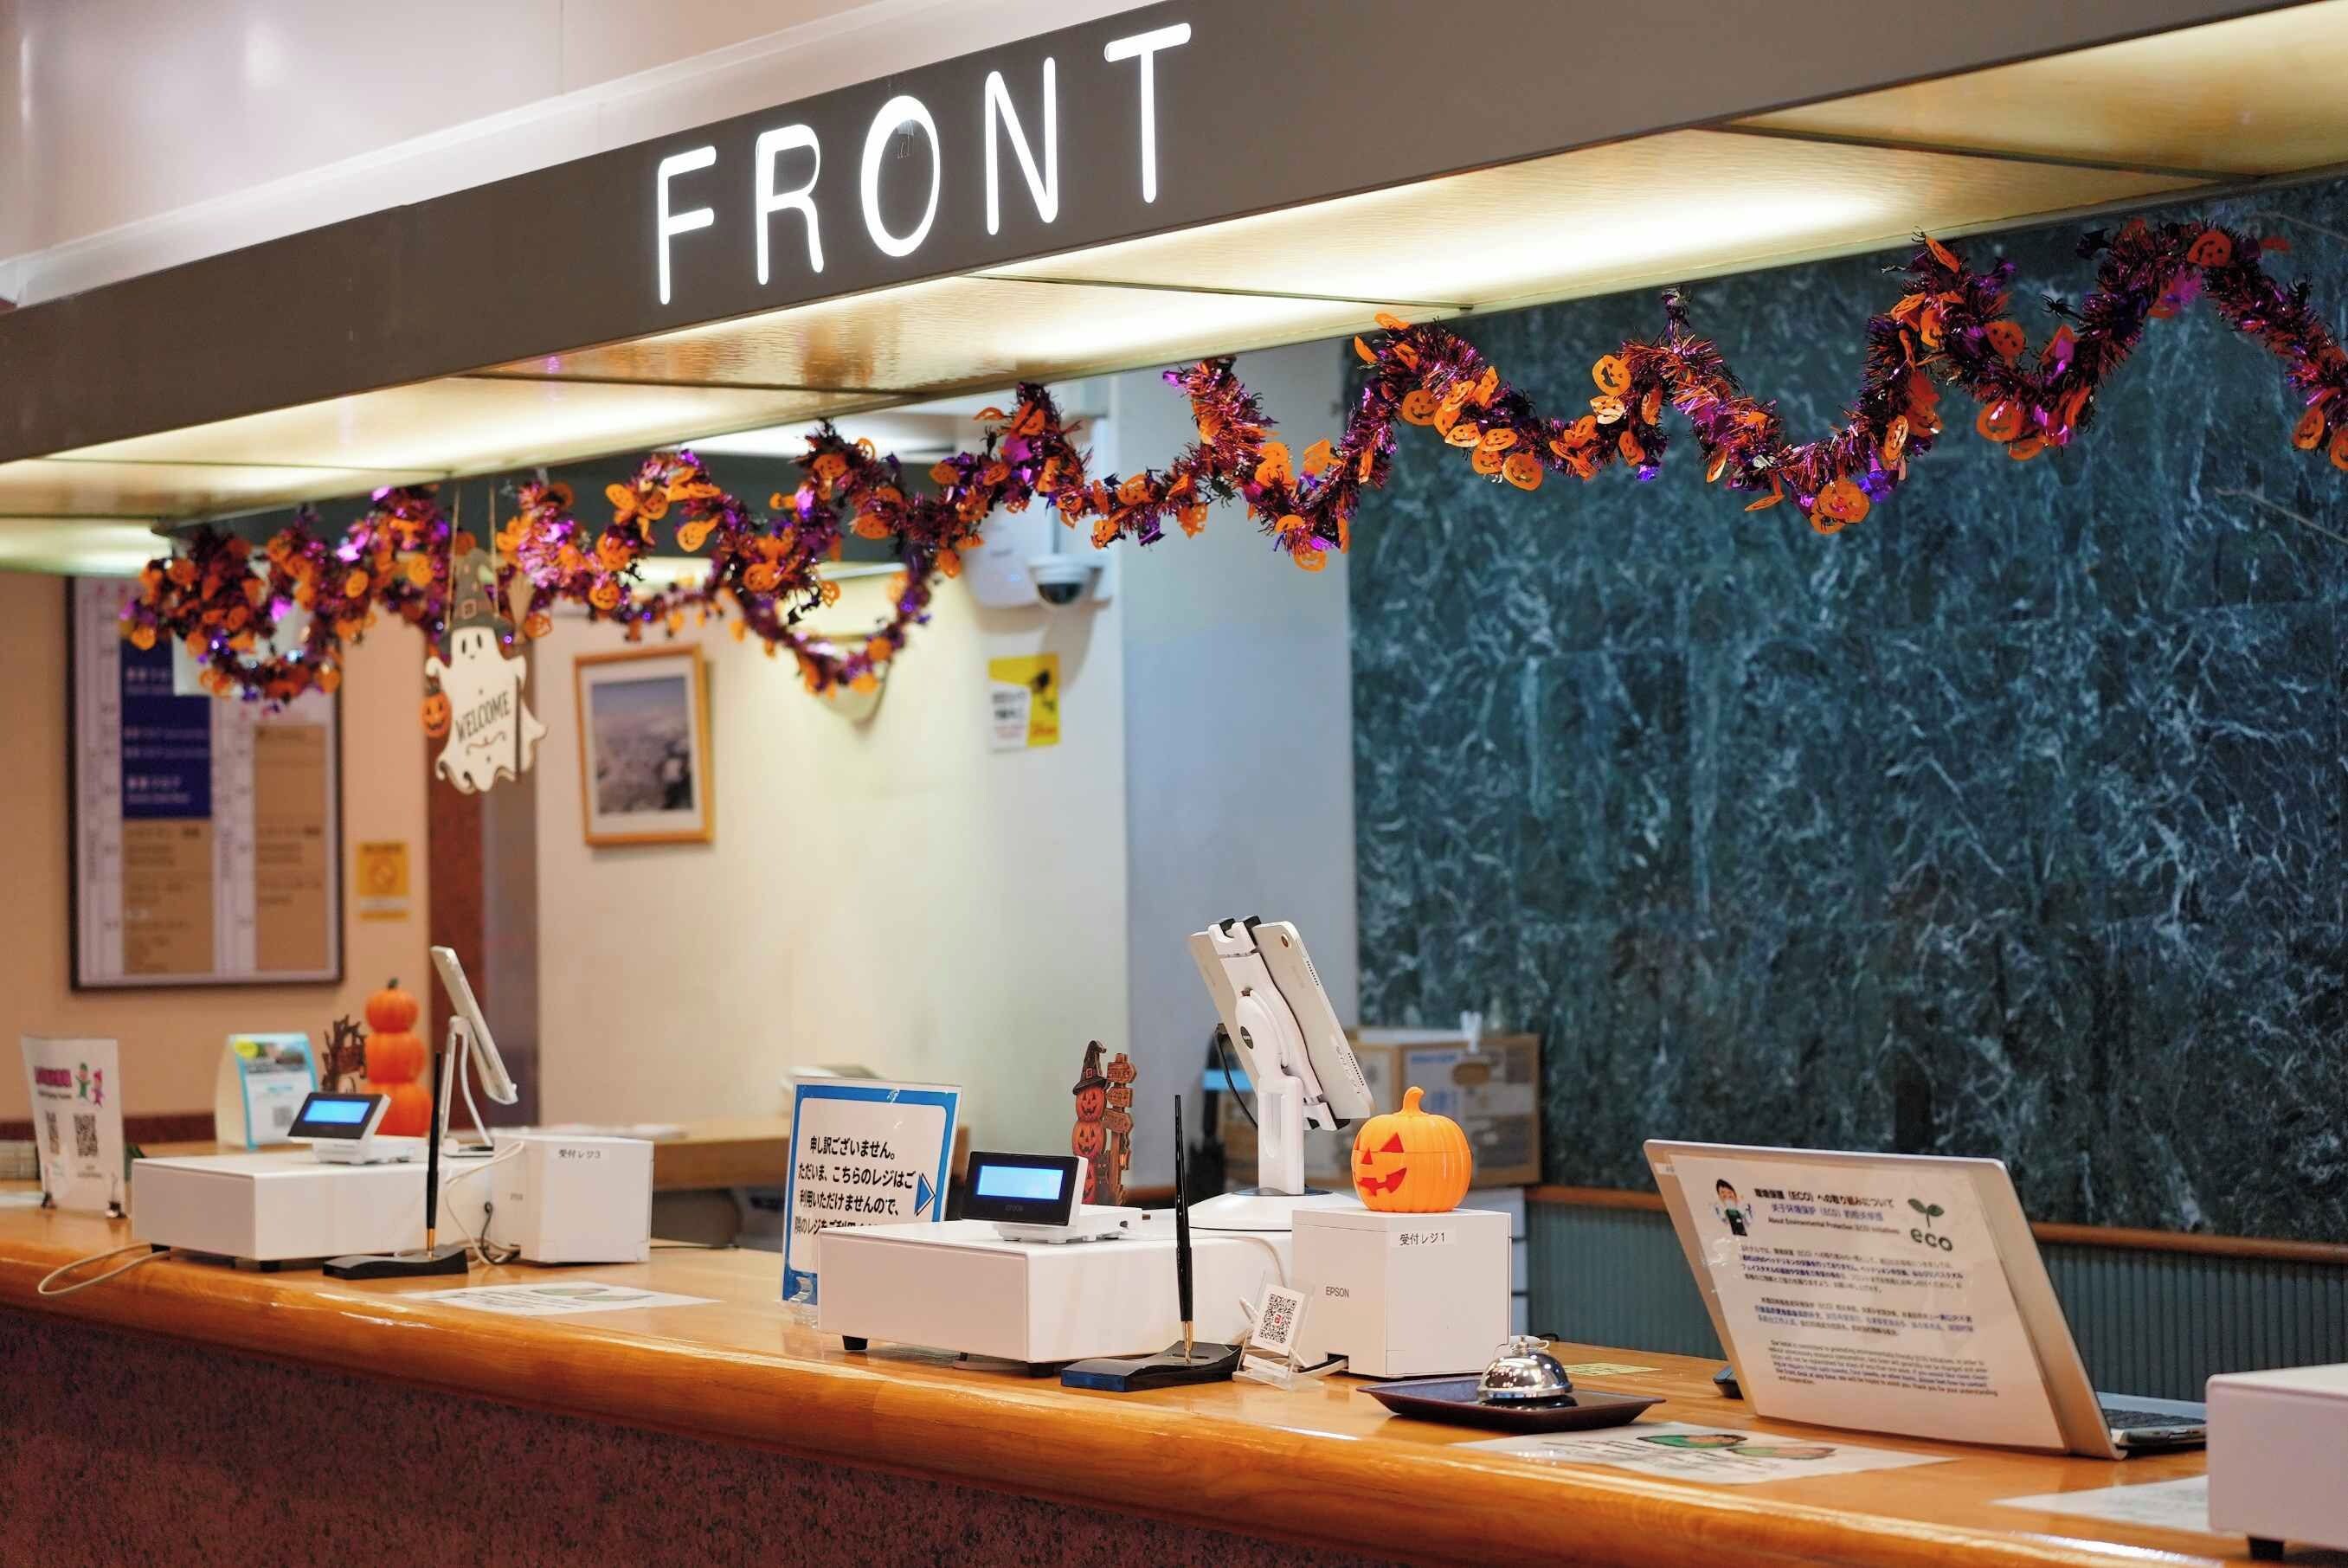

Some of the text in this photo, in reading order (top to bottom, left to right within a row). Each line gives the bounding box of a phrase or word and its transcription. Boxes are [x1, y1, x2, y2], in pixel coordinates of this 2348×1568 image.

[656, 22, 1192, 305] FRONT
[455, 690, 510, 742] WELCOME
[810, 1135, 895, 1160] 申し訳ございません。
[798, 1162, 916, 1189] ただいま、こちらのレジはご
[800, 1189, 898, 1216] 利用いただけませんので、
[1399, 1232, 1445, 1246] 受付レジ1
[1909, 1228, 1953, 1252] eco
[1325, 1286, 1350, 1299] EPSON
